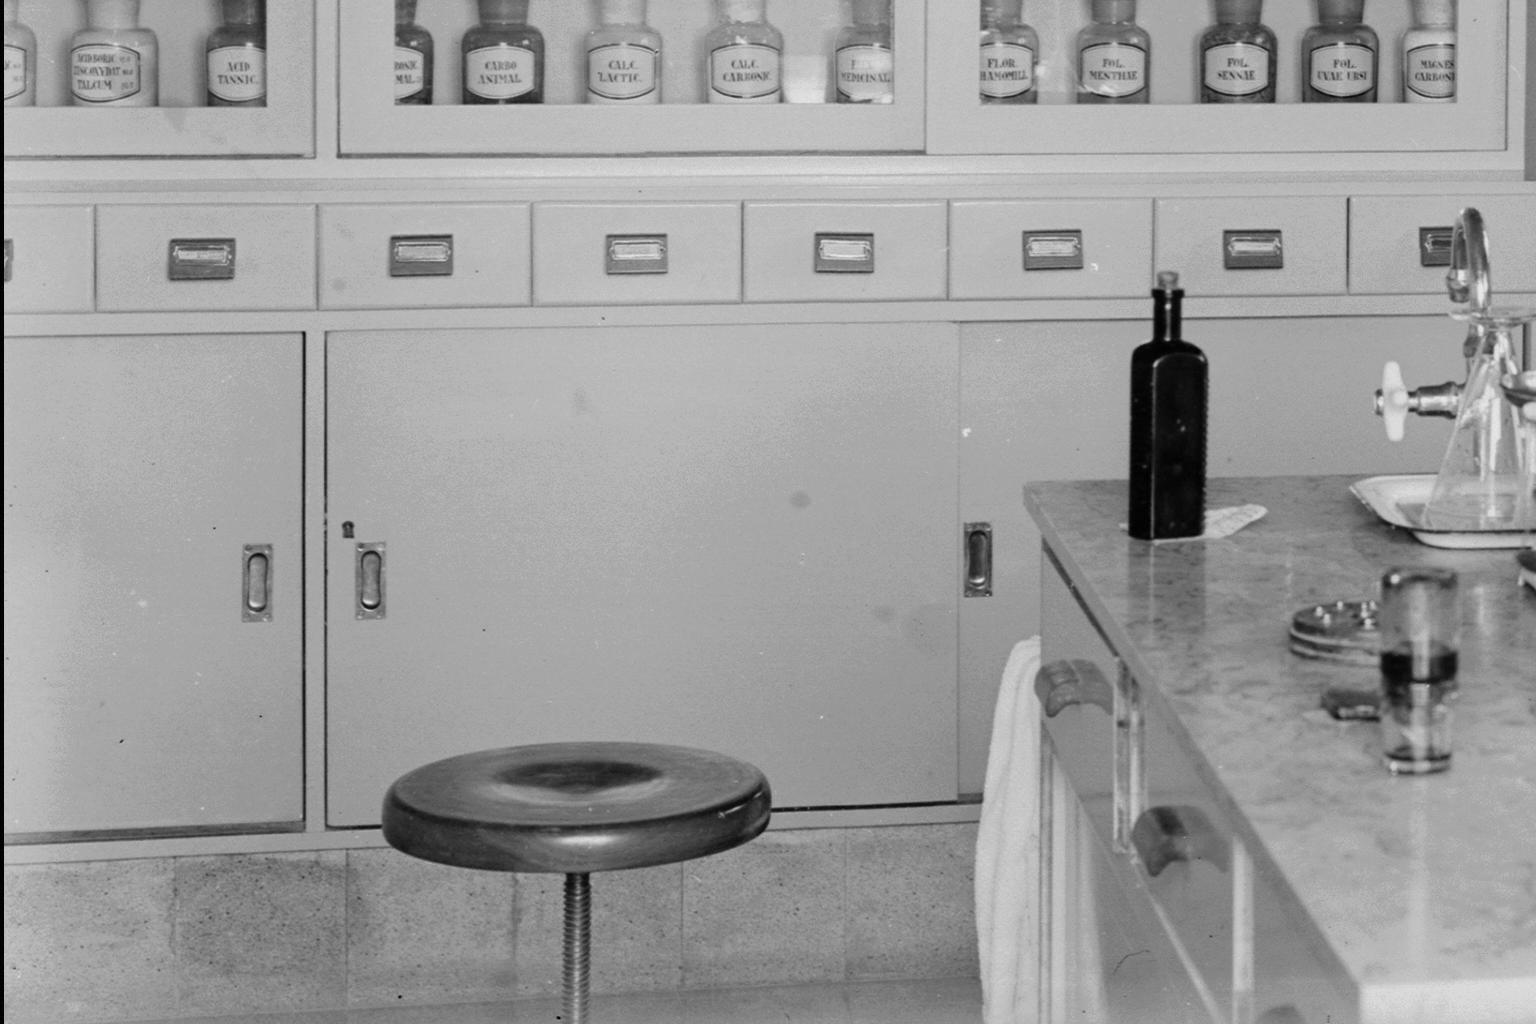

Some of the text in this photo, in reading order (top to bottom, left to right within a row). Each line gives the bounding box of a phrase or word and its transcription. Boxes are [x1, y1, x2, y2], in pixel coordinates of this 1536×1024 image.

[227, 61, 250, 72] ACID
[484, 61, 517, 71] CARBO
[1088, 70, 1138, 81] MENTHAE
